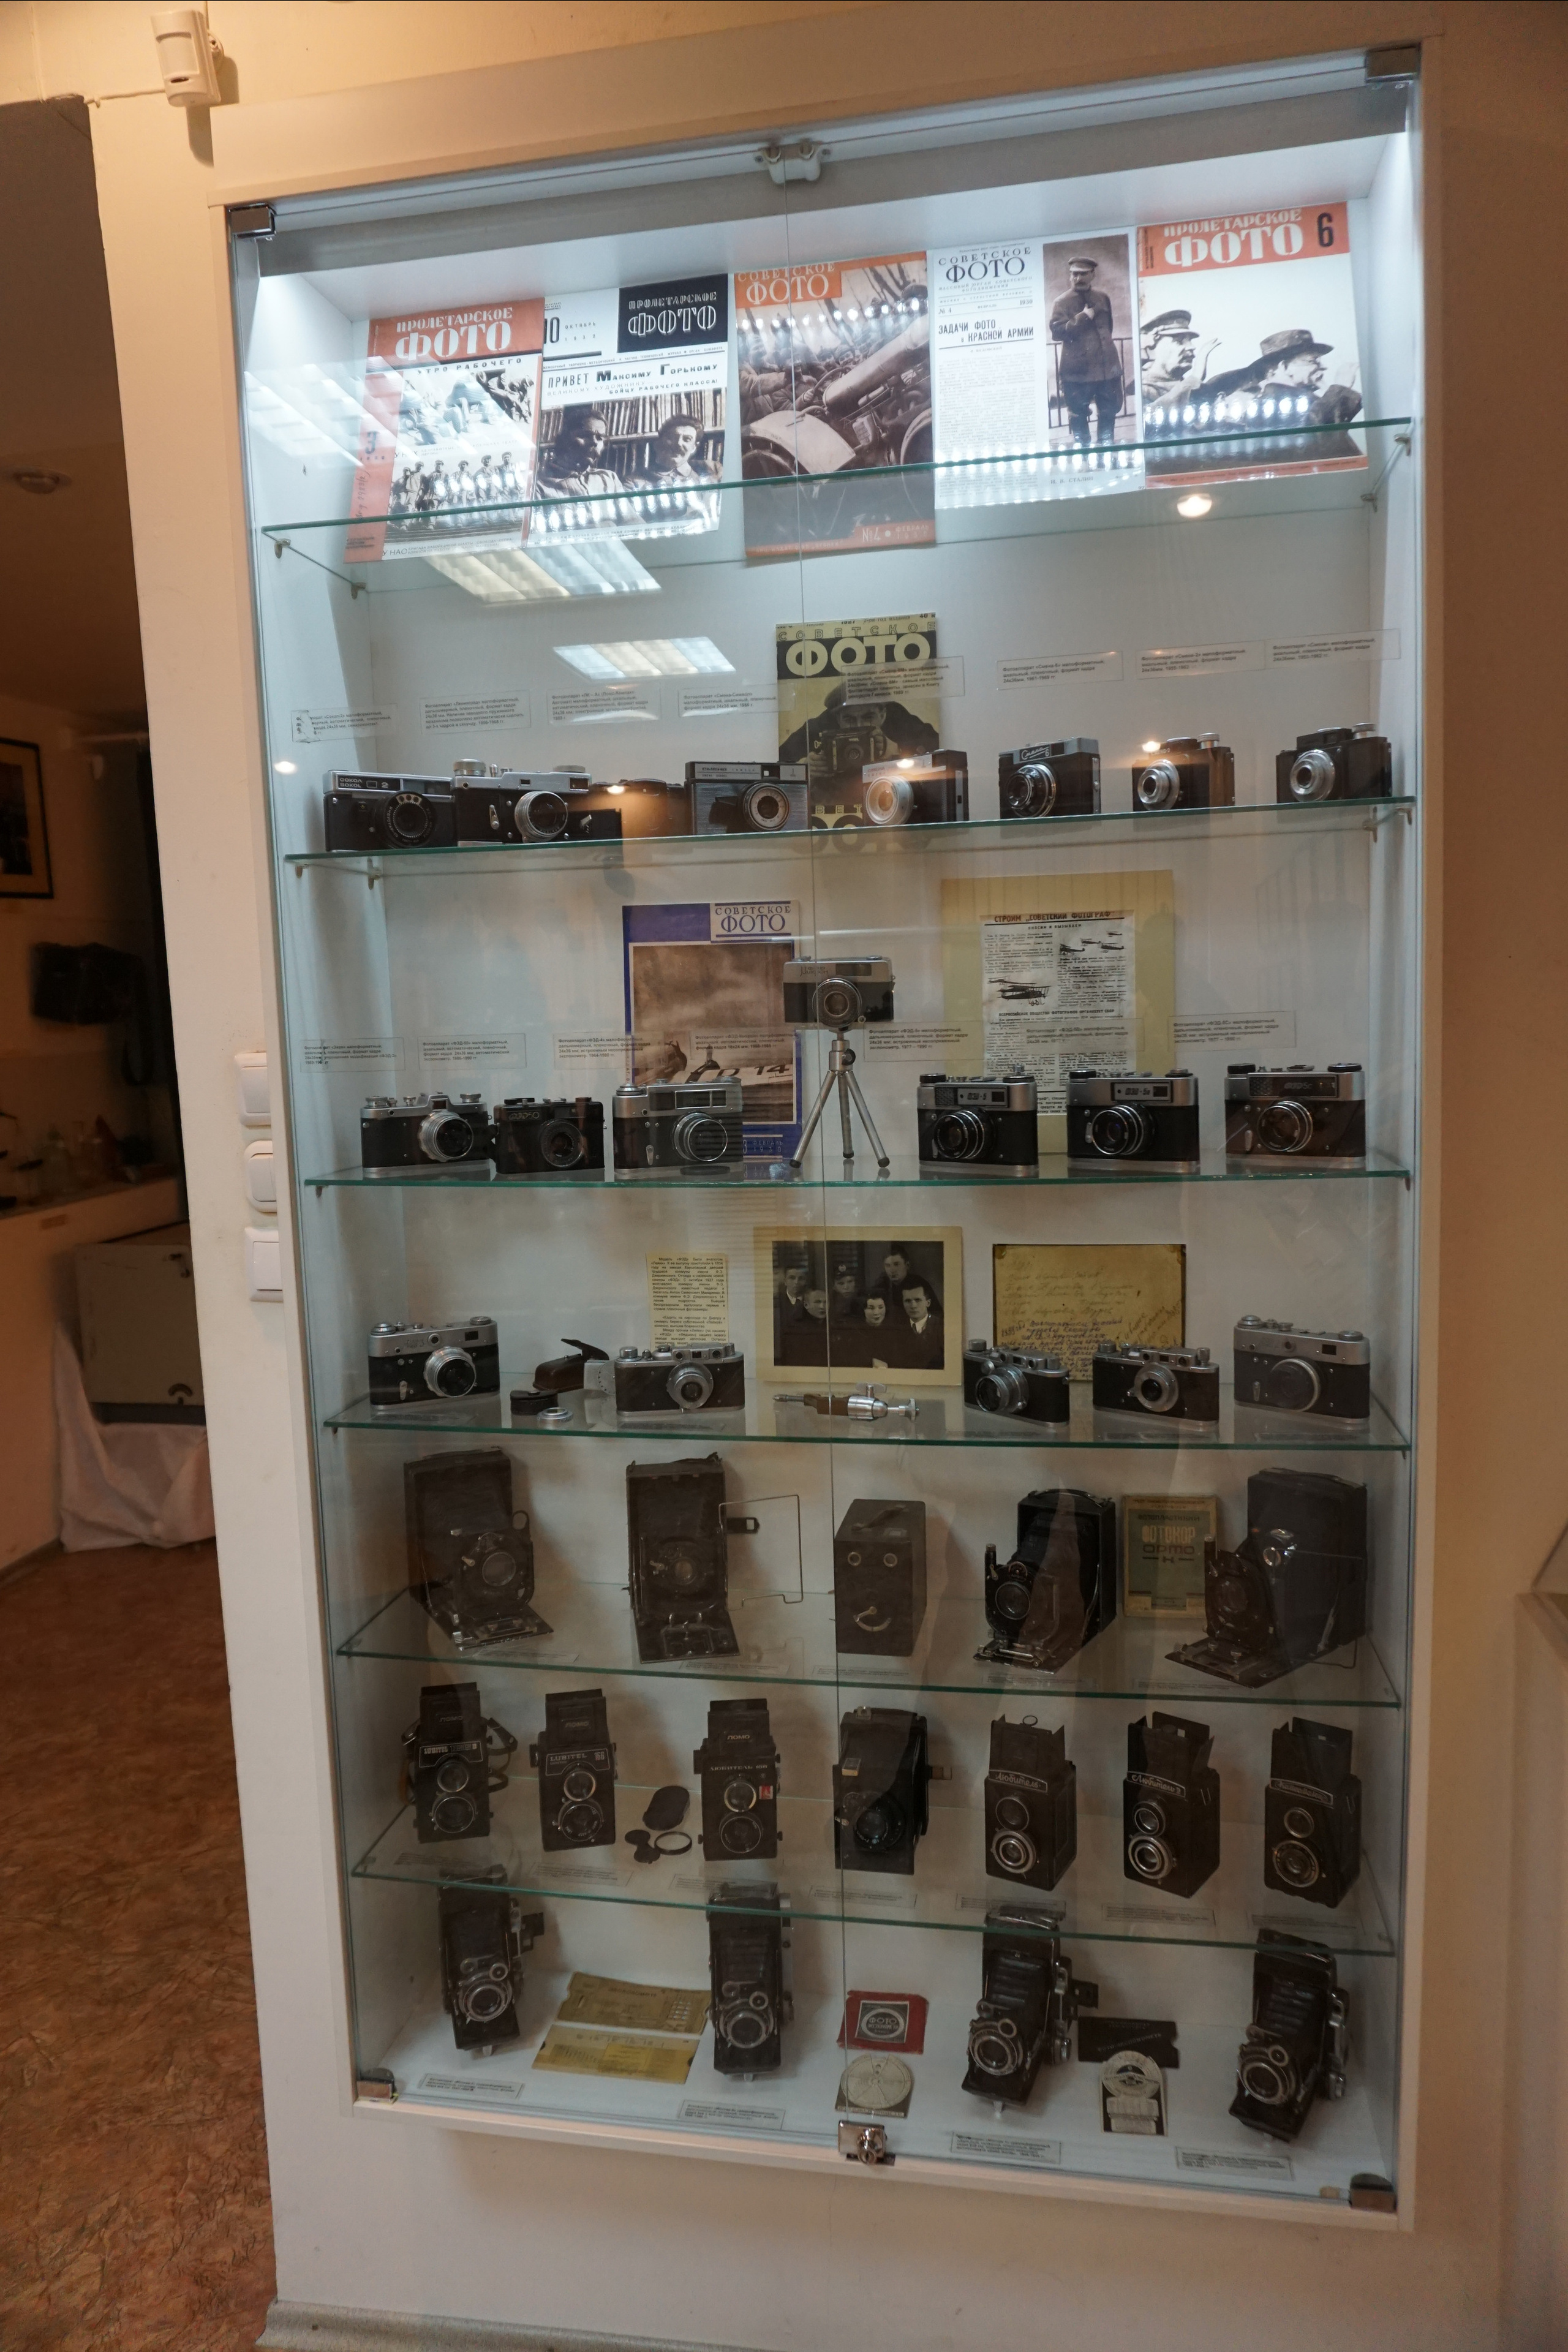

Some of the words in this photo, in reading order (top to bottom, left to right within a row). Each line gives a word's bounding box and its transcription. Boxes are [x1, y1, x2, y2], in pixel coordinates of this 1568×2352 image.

[1164, 208, 1302, 238] ПРОЛЕТАРСКОЕ
[1317, 212, 1335, 247] 6
[1164, 222, 1303, 267] ФОТО
[938, 246, 1031, 266] СОВЕТСКОЕ
[737, 262, 836, 282] СОВЕТСКОЕ
[946, 257, 1025, 283] ФОТО
[746, 274, 829, 306] ФОТО
[628, 291, 717, 310] ПРОЛЕТАРСКОЕ
[396, 307, 513, 333] ПРОЛЕТАРСКОЕ
[628, 305, 717, 337] ФОТО
[938, 322, 968, 334] ЗАДАЧИ
[974, 319, 996, 330] ФОТО
[395, 321, 511, 361] ФОТО
[968, 330, 1003, 342] КРАСНОЙ
[1008, 326, 1034, 338] АРМИИ
[456, 358, 522, 371] РАБОЧЕГО
[548, 372, 589, 389] ПРИВЕТ
[778, 621, 936, 641] СОВЕТСКОЕ
[785, 632, 931, 677] ФОТО
[715, 905, 791, 916] СОВЕТСКОЕ
[720, 914, 786, 933] ФОТО
